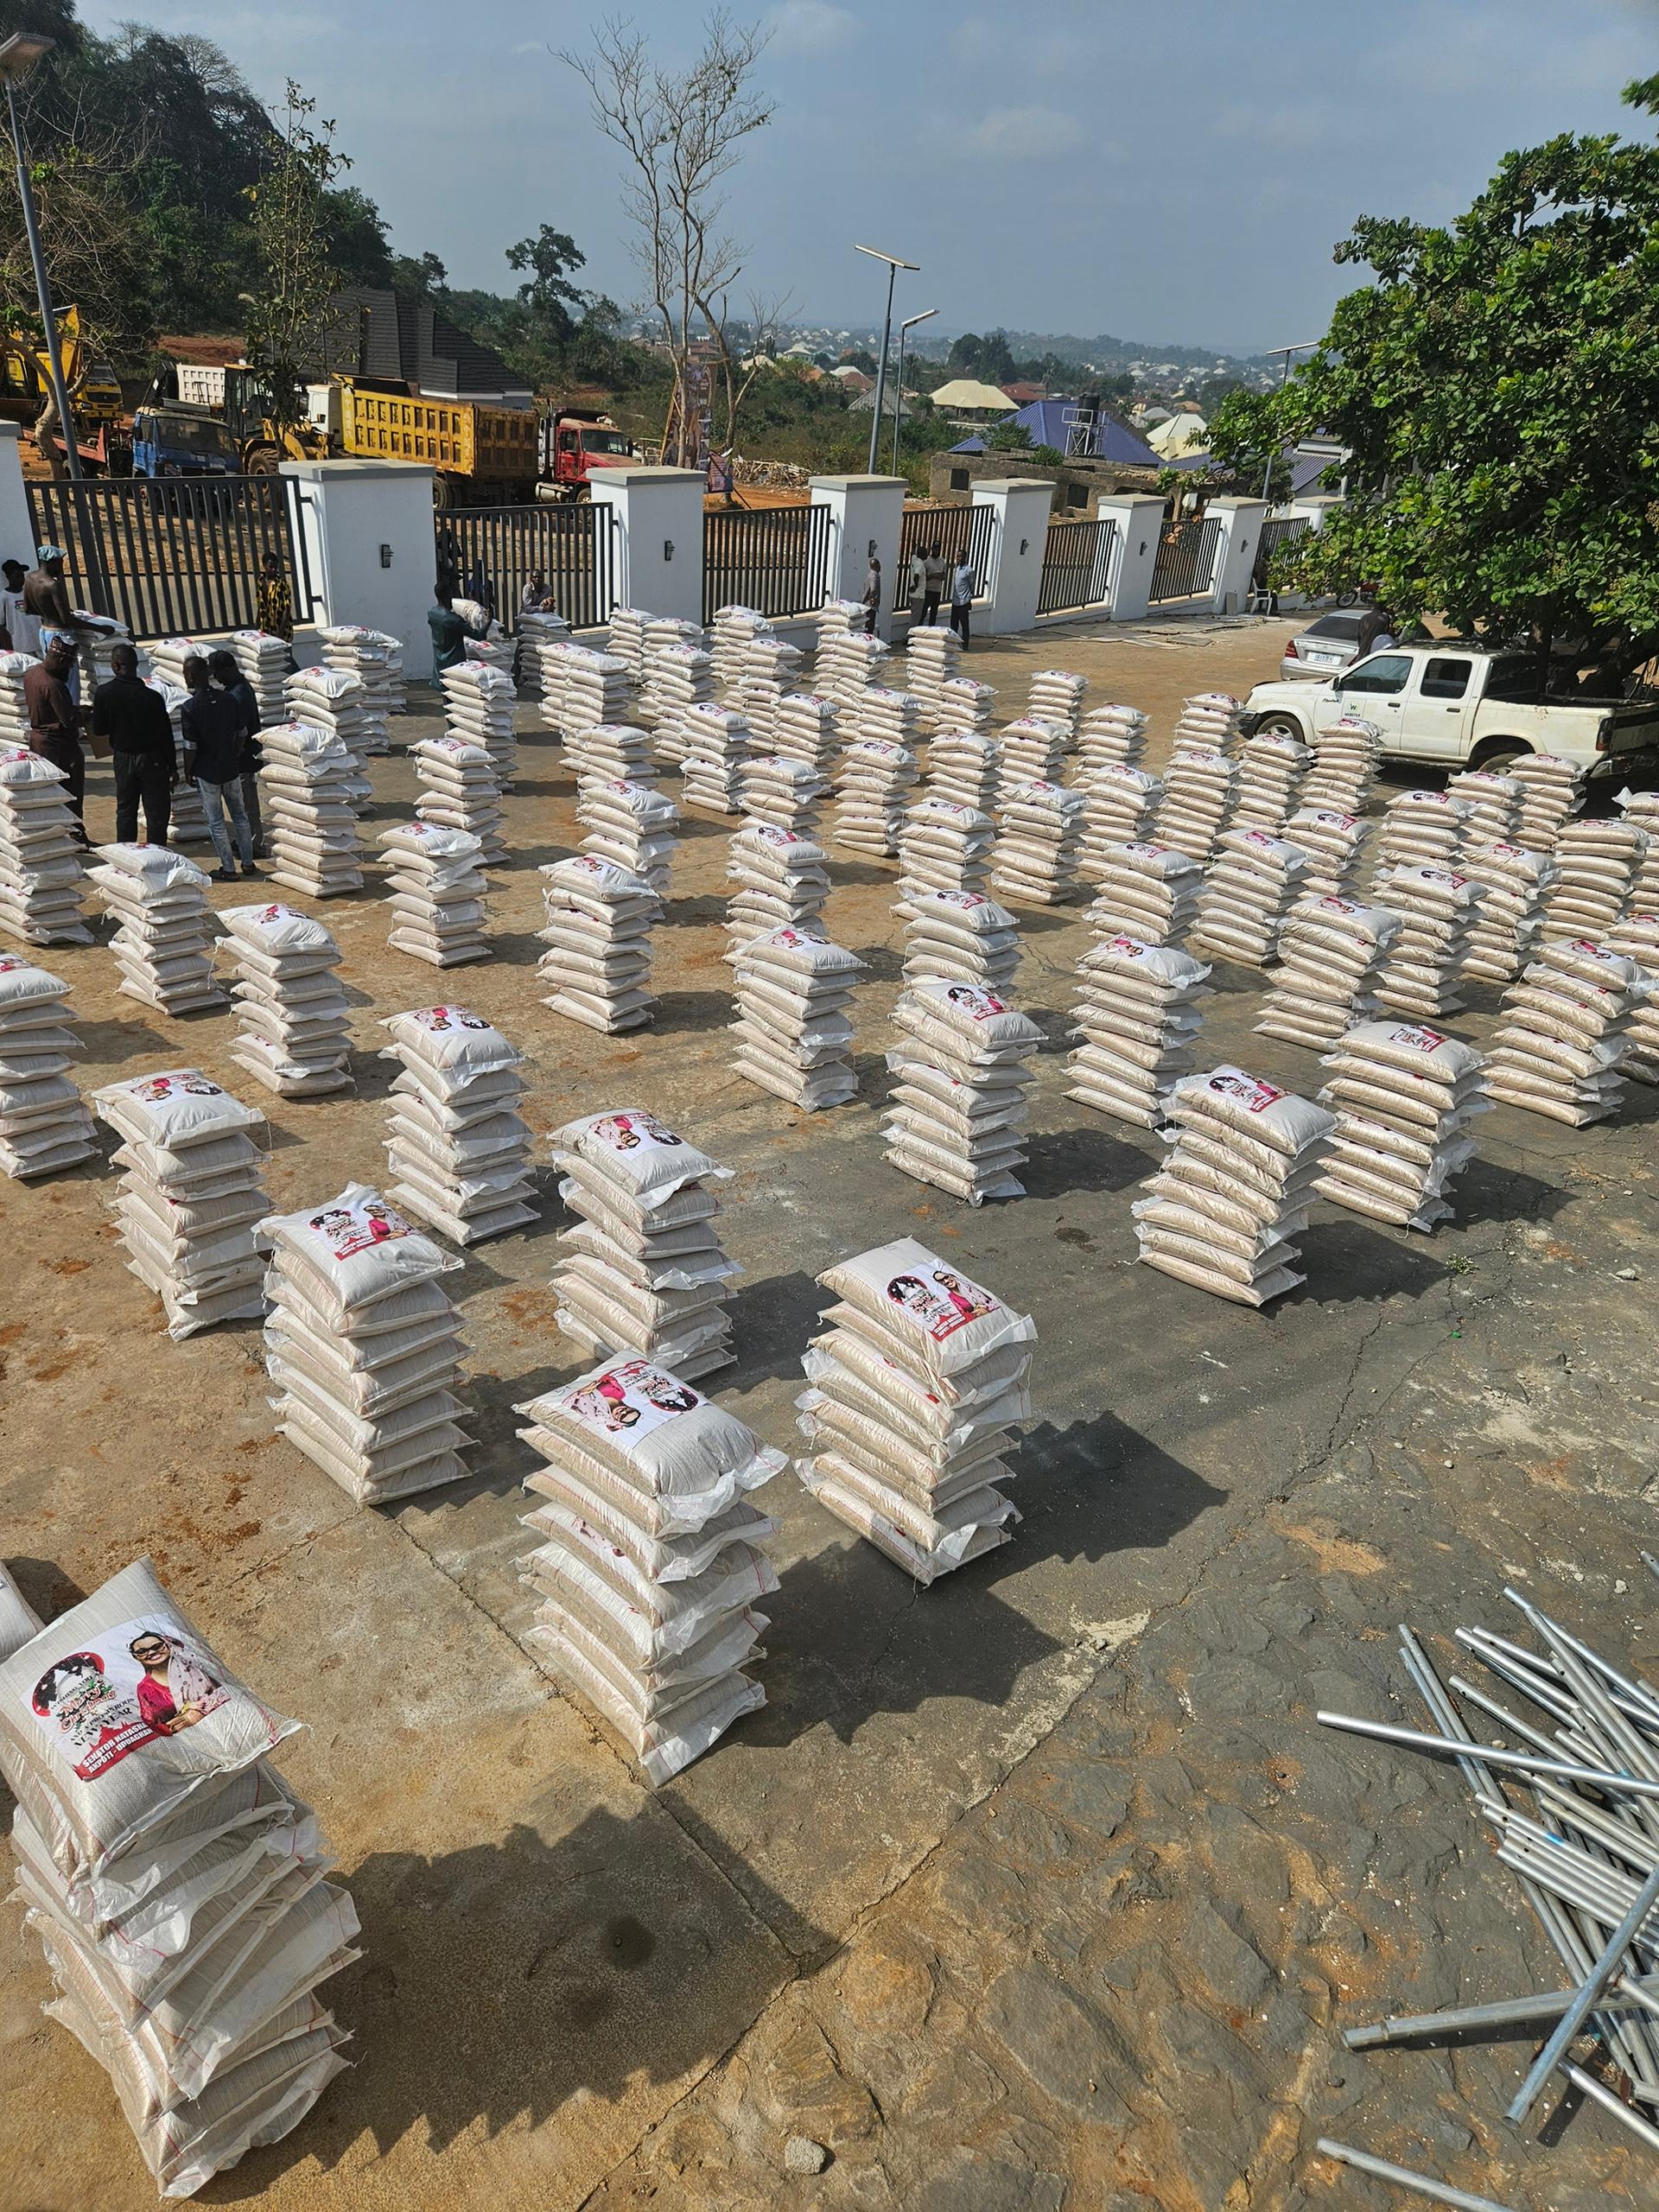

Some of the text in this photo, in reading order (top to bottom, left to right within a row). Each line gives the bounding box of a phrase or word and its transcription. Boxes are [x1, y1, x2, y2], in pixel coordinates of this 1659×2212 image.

[79, 1675, 93, 1686] YOU
[60, 1686, 101, 1717] Merry
[60, 1690, 117, 1733] Christmas
[74, 1707, 133, 1746] NEW YEAR
[82, 1738, 116, 1768] SENATOR
[88, 1751, 115, 1774] AKPOTI
